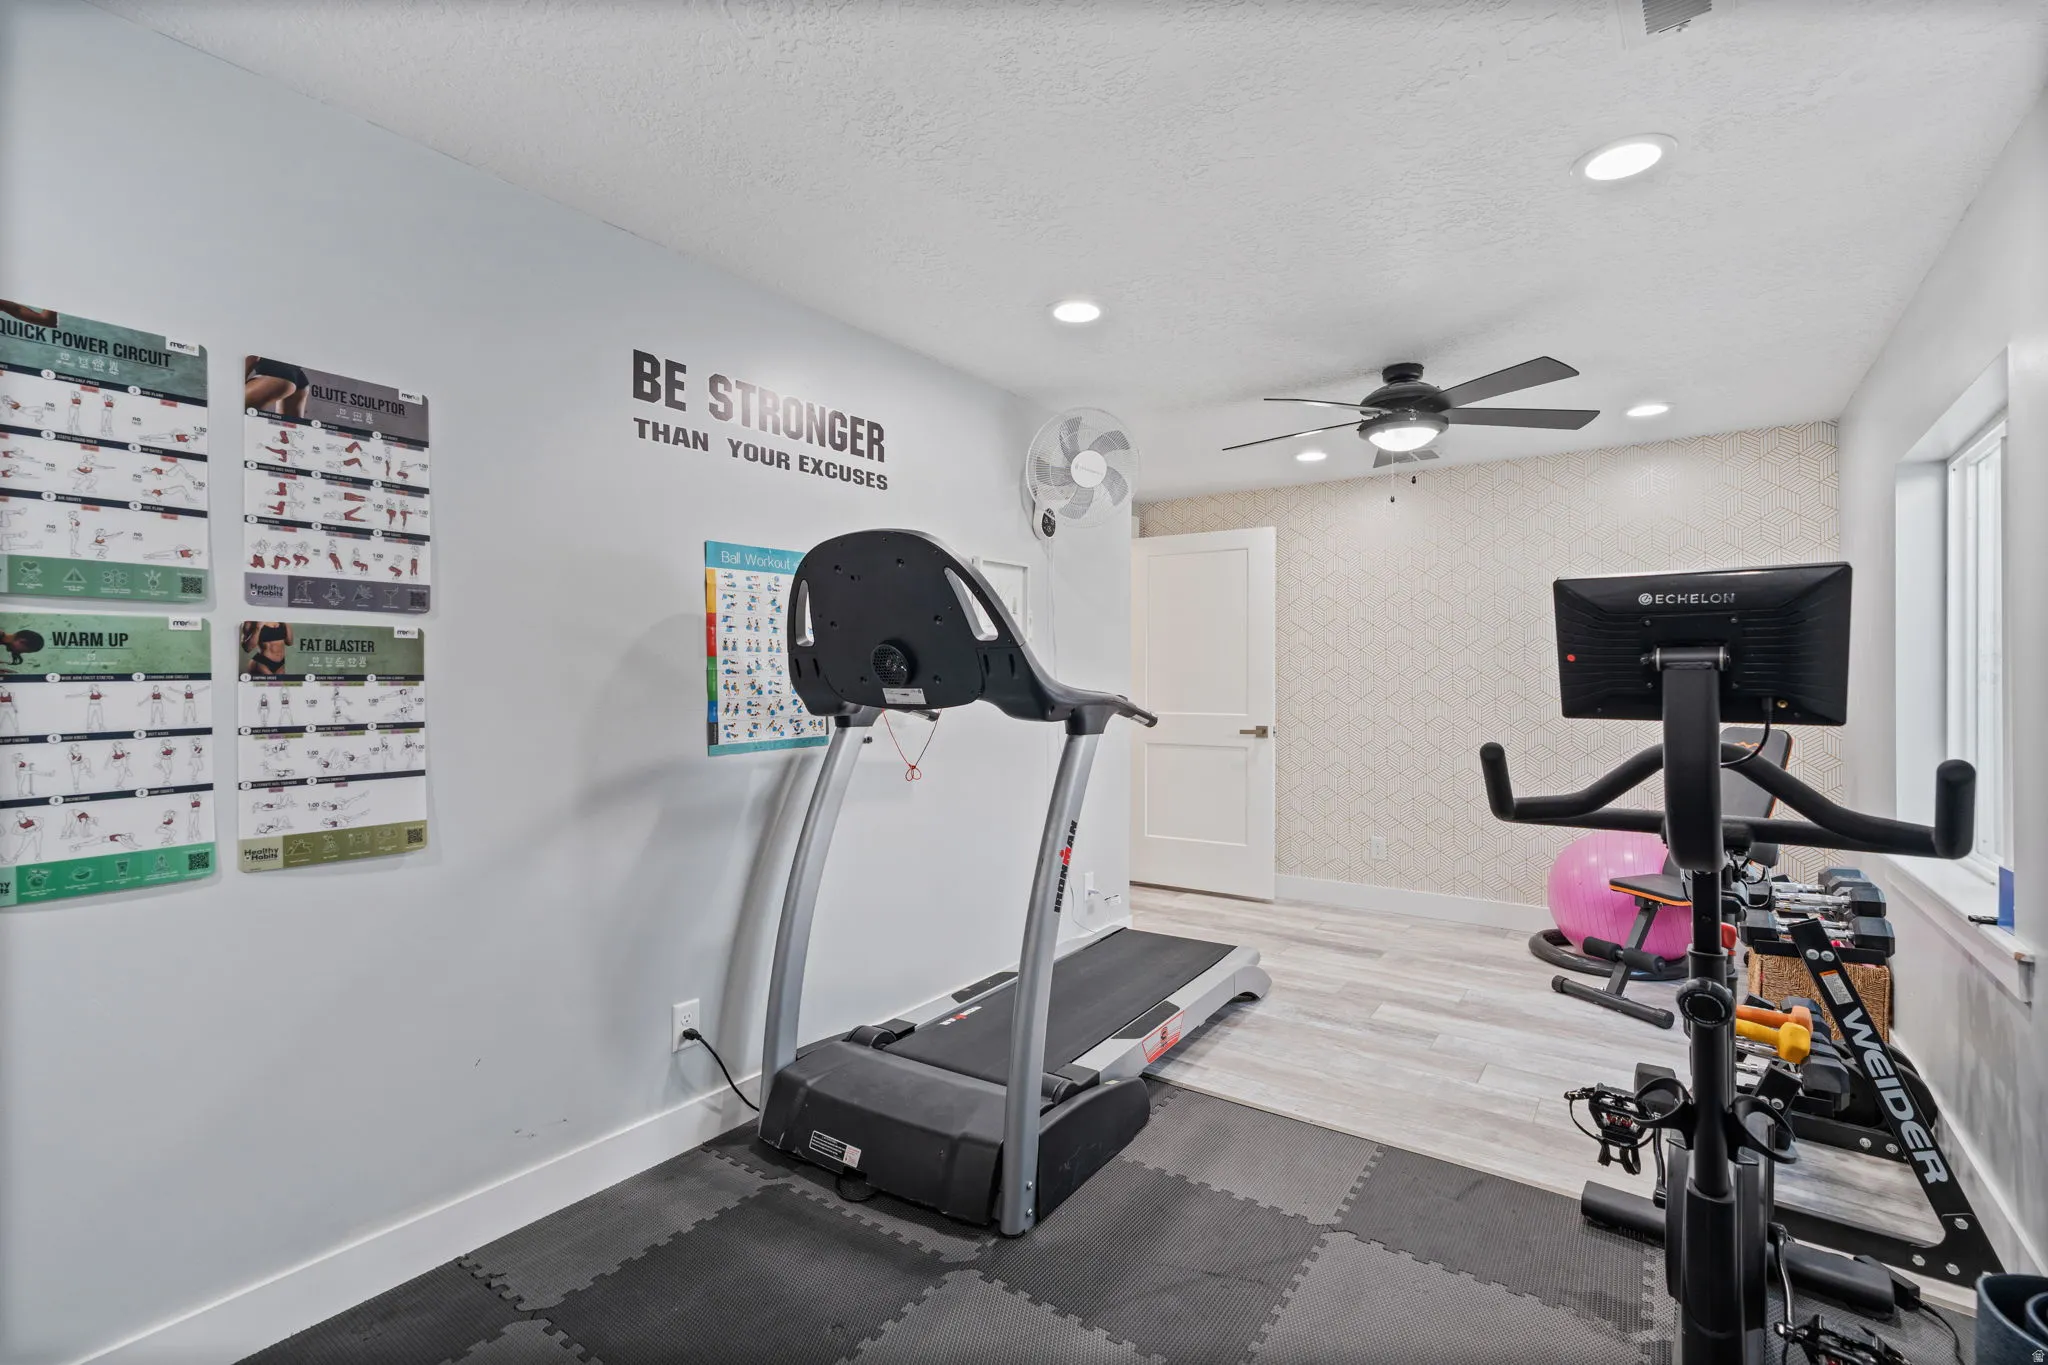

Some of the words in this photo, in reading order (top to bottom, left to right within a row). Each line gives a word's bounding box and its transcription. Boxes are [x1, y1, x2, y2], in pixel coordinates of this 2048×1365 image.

[0, 318, 46, 342] QUICK
[52, 330, 109, 355] POWER
[113, 343, 171, 368] CIRCUIT
[311, 384, 348, 404] GLUTE
[350, 393, 405, 415] SCULPTOR
[633, 349, 687, 412] BE
[708, 373, 885, 463] STRONGER
[633, 417, 709, 452] THAN
[727, 438, 790, 471] YOUR
[798, 454, 888, 491] EXCUSES
[721, 551, 741, 563] Ball
[745, 553, 791, 570] Workout
[250, 583, 284, 592] Healthy
[257, 589, 283, 597] Habits
[1655, 593, 1735, 604] ECHELON
[52, 631, 104, 647] WARM
[108, 632, 129, 647] UP
[300, 638, 322, 652] FAT
[325, 639, 375, 652] BLASTER
[244, 847, 279, 857] Healthy
[1054, 819, 1078, 913] IRONMAN
[1843, 1007, 1949, 1185] WEIDER
